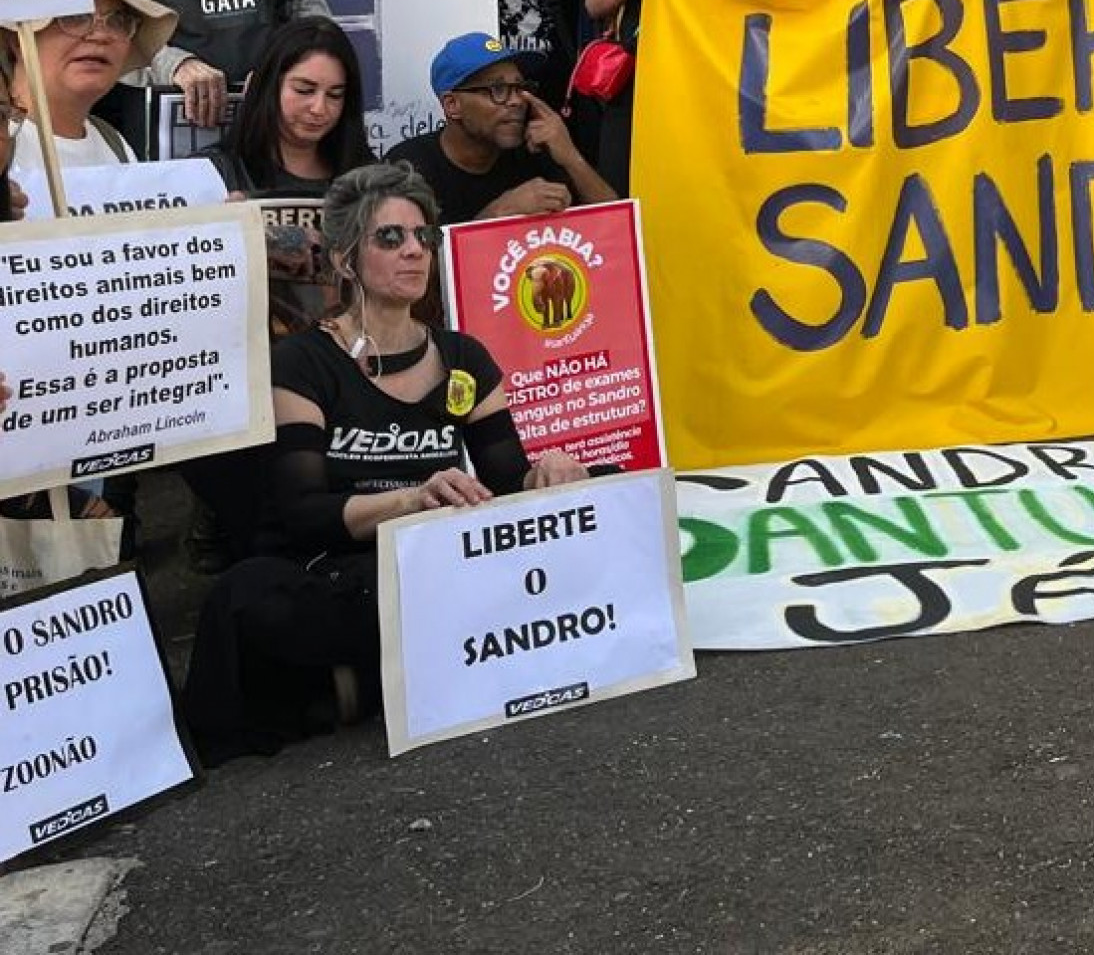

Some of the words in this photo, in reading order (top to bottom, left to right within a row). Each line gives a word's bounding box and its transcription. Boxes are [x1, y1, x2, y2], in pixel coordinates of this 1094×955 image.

[50, 250, 93, 271] sou
[101, 249, 116, 264] a
[122, 241, 180, 262] favor
[186, 236, 224, 254] dos
[492, 239, 527, 312] VOCÊ
[525, 226, 605, 269] SABIA?
[97, 268, 185, 294] animais
[191, 262, 236, 282] bem
[15, 312, 84, 335] como
[91, 304, 133, 325] dos
[140, 292, 222, 318] direitos
[70, 328, 178, 359] humanos.
[18, 375, 76, 399] Essa
[84, 367, 97, 388] é
[105, 369, 117, 384] a
[125, 349, 220, 384] proposta
[511, 370, 544, 387] Que
[546, 357, 582, 379] NÃO
[584, 351, 608, 371] HÁ
[562, 378, 583, 394] de
[585, 366, 641, 389] exames
[2, 411, 33, 432] de
[41, 404, 77, 423] um
[85, 395, 123, 416] ser
[567, 396, 586, 410] no
[588, 384, 640, 406] Sandro
[85, 422, 152, 445] Abraham
[155, 410, 206, 431] Lincoln
[551, 416, 571, 434] de
[572, 400, 646, 429] estrutura?
[587, 426, 642, 446] assistência
[462, 504, 597, 559] LIBERTE
[524, 567, 547, 595] O
[4, 627, 24, 656] O
[31, 592, 133, 648] SANDRO
[463, 603, 617, 667] SANDRO!
[4, 650, 113, 711] PRISÃO!
[1, 735, 97, 793] ZOONÃO
